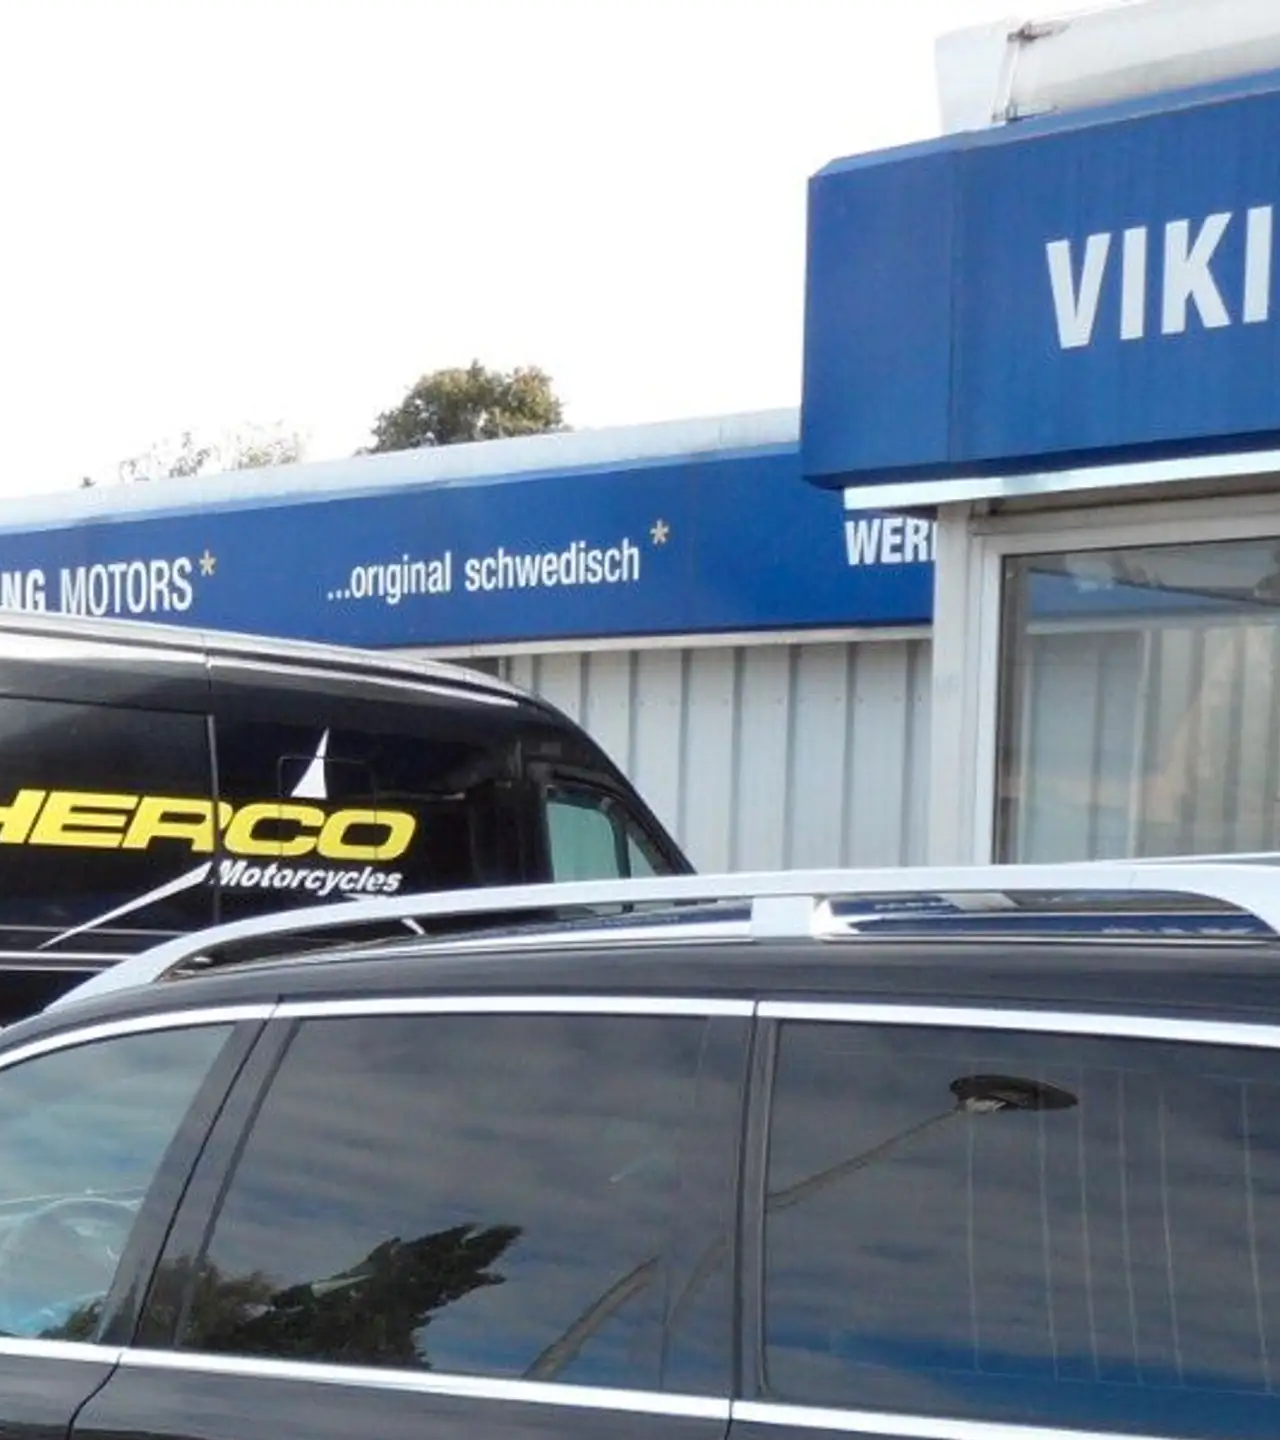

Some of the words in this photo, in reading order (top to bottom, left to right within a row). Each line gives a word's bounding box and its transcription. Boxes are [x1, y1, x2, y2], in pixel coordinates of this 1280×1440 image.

[464, 537, 640, 592] schwedisch
[844, 516, 937, 566] WER
[60, 556, 193, 617] MOTORS
[218, 859, 404, 897] Motorcycles
